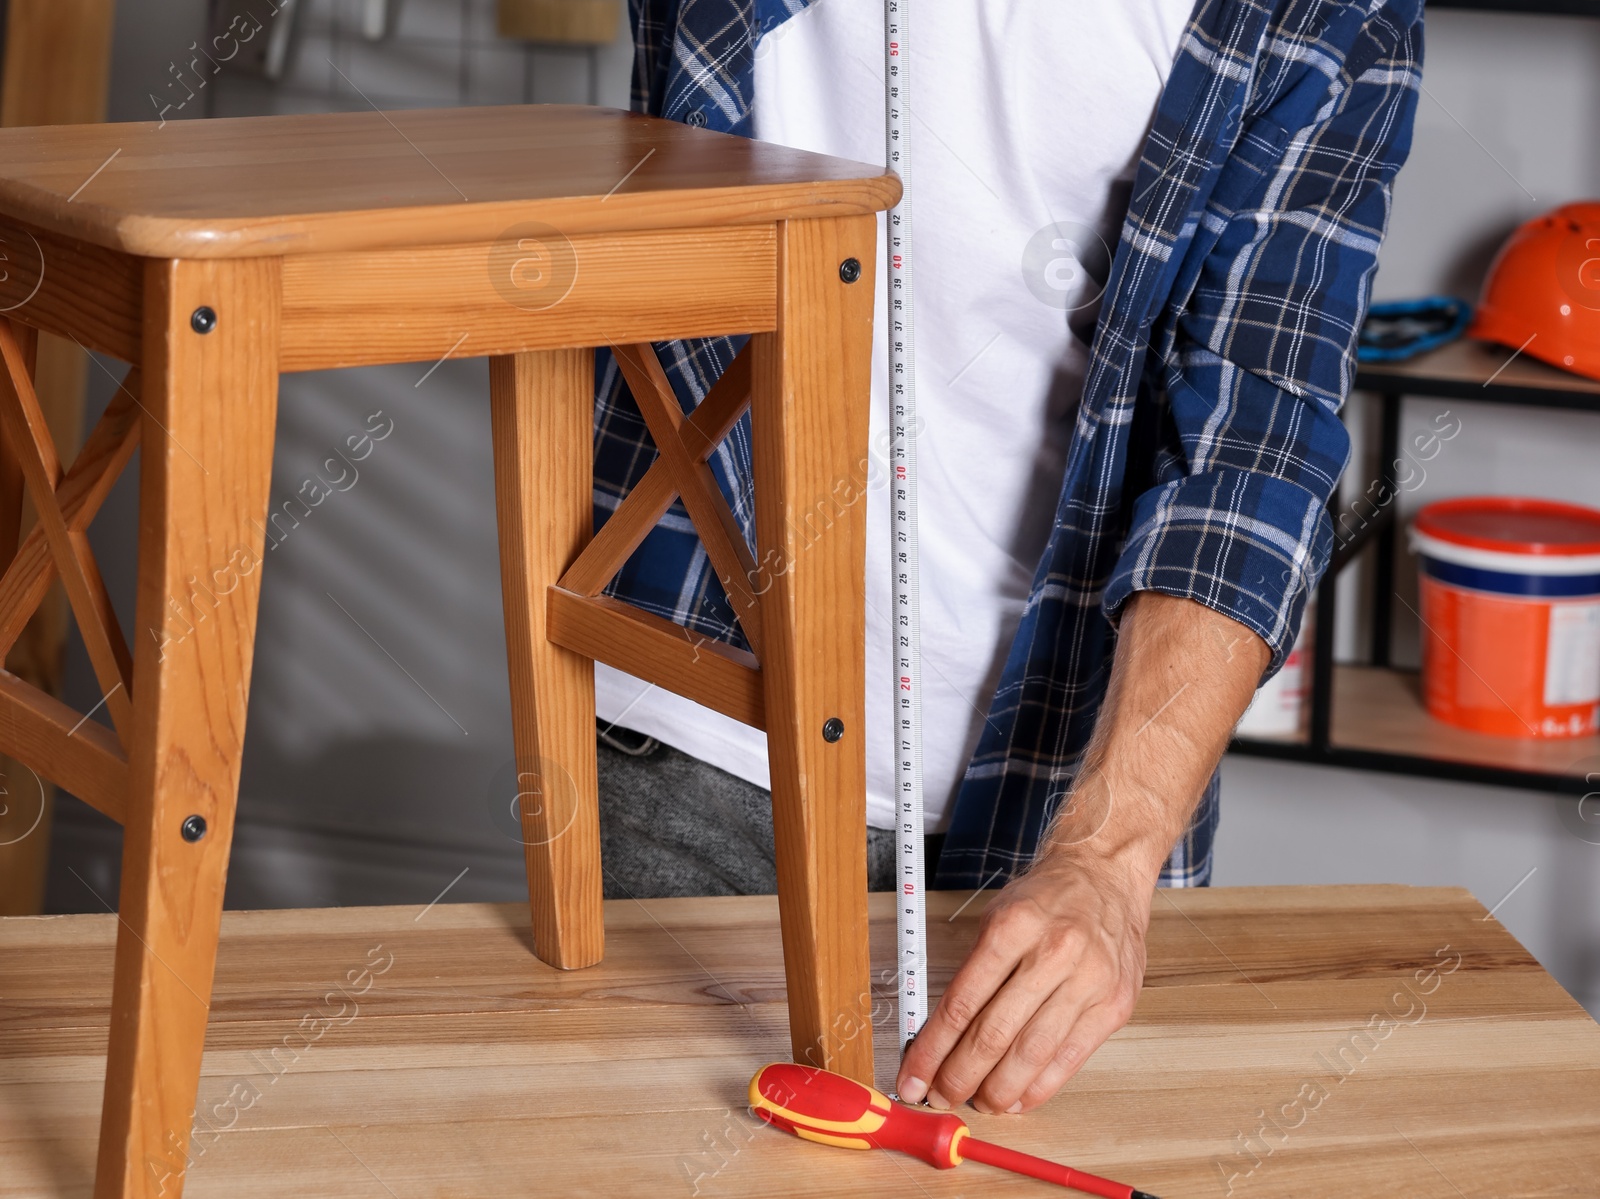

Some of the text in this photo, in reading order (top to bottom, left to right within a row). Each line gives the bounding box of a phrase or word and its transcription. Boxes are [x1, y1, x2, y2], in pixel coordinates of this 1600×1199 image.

[890, 2, 898, 12] 52
[890, 24, 898, 34] 51
[890, 42, 898, 56] 50
[890, 66, 898, 76] 49
[890, 86, 898, 98] 48
[890, 108, 898, 120] 47
[892, 130, 900, 140] 46
[892, 150, 900, 162] 45
[892, 214, 900, 226] 42
[892, 236, 900, 246] 41
[892, 254, 902, 270] 40
[894, 278, 902, 290] 39
[894, 300, 902, 310] 38
[894, 320, 902, 332] 37
[894, 342, 902, 352] 36
[894, 362, 904, 374] 35
[896, 384, 904, 394] 34
[896, 404, 904, 416] 33
[896, 426, 904, 438] 32
[896, 448, 904, 458] 31
[897, 466, 906, 480] 30
[896, 490, 906, 500] 29
[898, 510, 906, 522] 28
[898, 532, 906, 542] 27
[898, 552, 906, 564] 26
[898, 574, 908, 584] 25
[900, 594, 908, 606] 24
[900, 614, 908, 626] 23
[900, 636, 908, 646] 22
[900, 658, 908, 668] 21
[901, 676, 910, 690] 20
[902, 698, 910, 708] 19
[902, 720, 910, 730] 18
[902, 740, 910, 750] 17
[902, 760, 912, 770] 16
[902, 782, 912, 792] 15
[904, 802, 912, 812] 14
[904, 824, 912, 834] 13
[904, 844, 912, 854] 12
[904, 866, 912, 874] 11
[905, 884, 914, 896] 10
